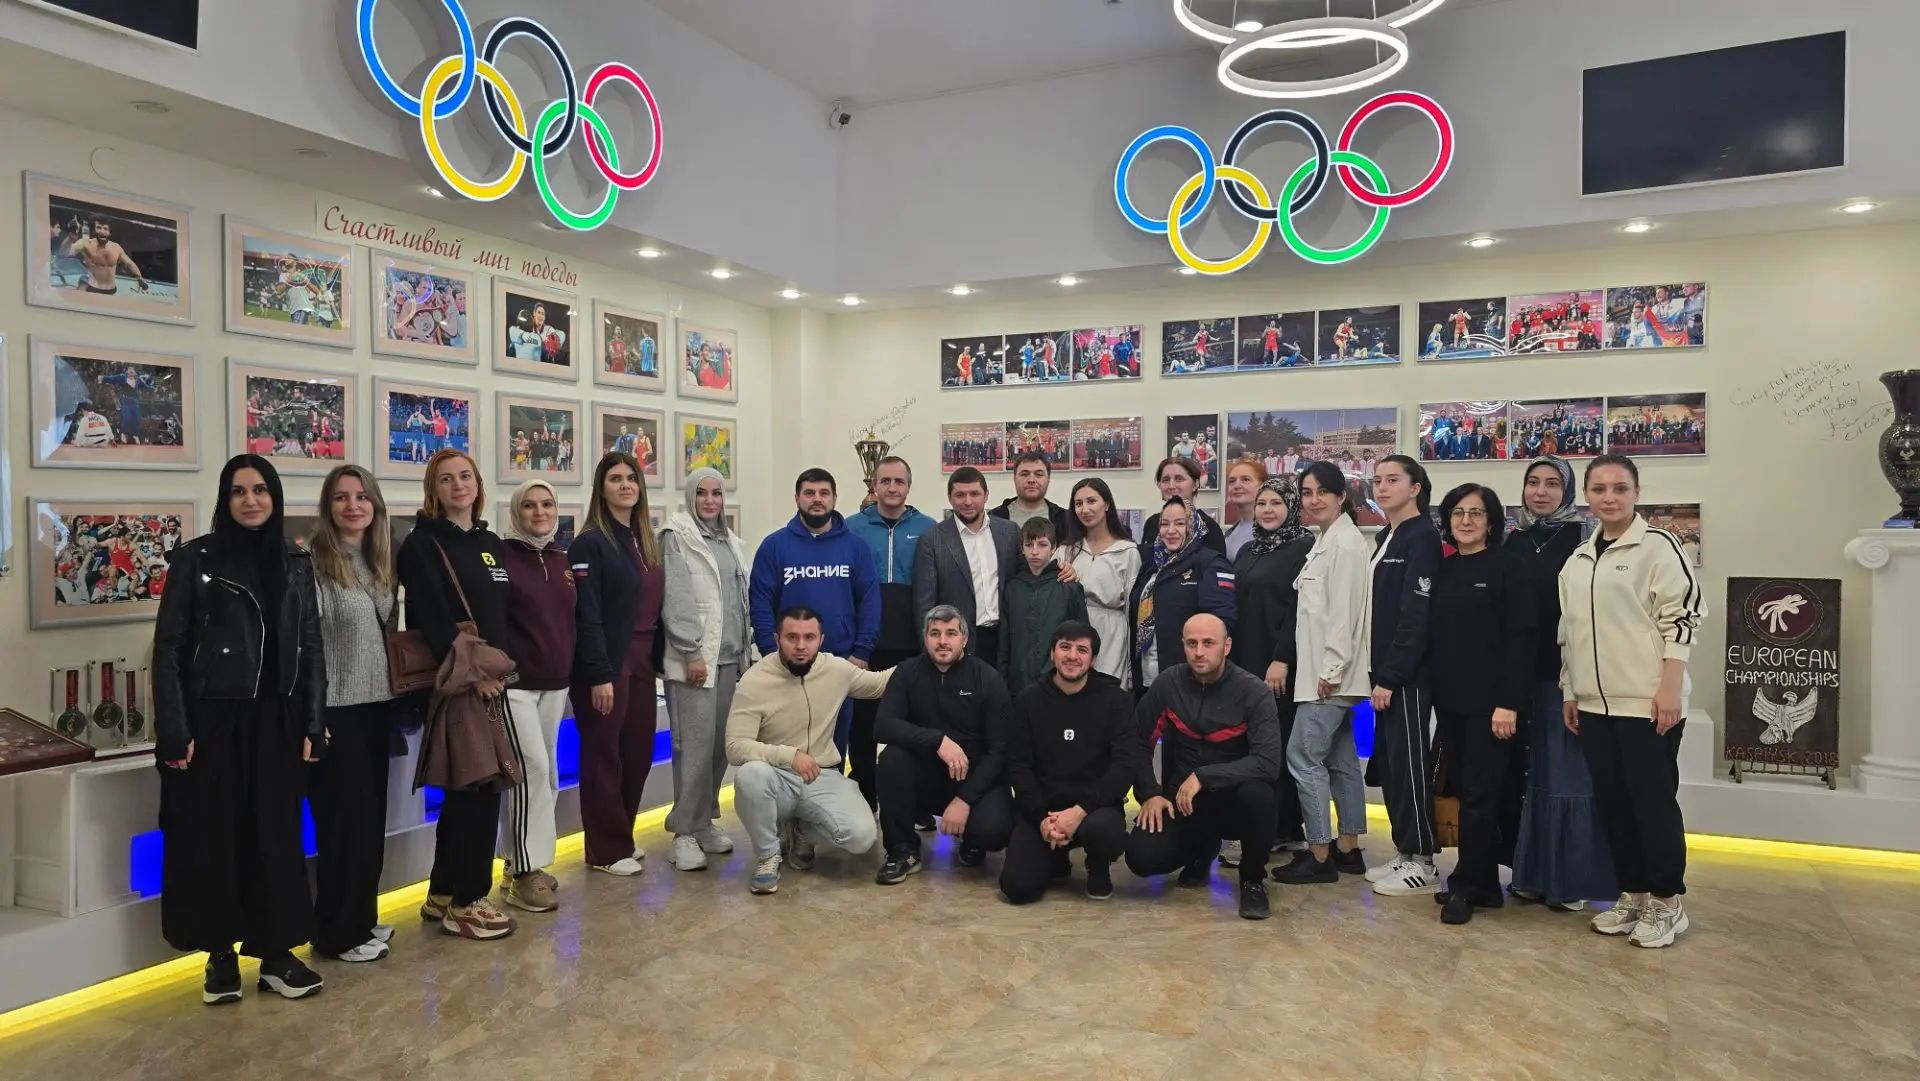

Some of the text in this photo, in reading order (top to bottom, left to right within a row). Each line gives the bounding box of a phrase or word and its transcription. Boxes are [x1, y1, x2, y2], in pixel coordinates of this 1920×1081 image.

[324, 205, 578, 287] Счастливый миг победы
[783, 564, 850, 585] ЗНАНИЕ
[1728, 645, 1838, 669] EUROPEAN
[1725, 669, 1840, 687] CHAMPIONSHIPS
[1725, 746, 1799, 763] KASPIYSK
